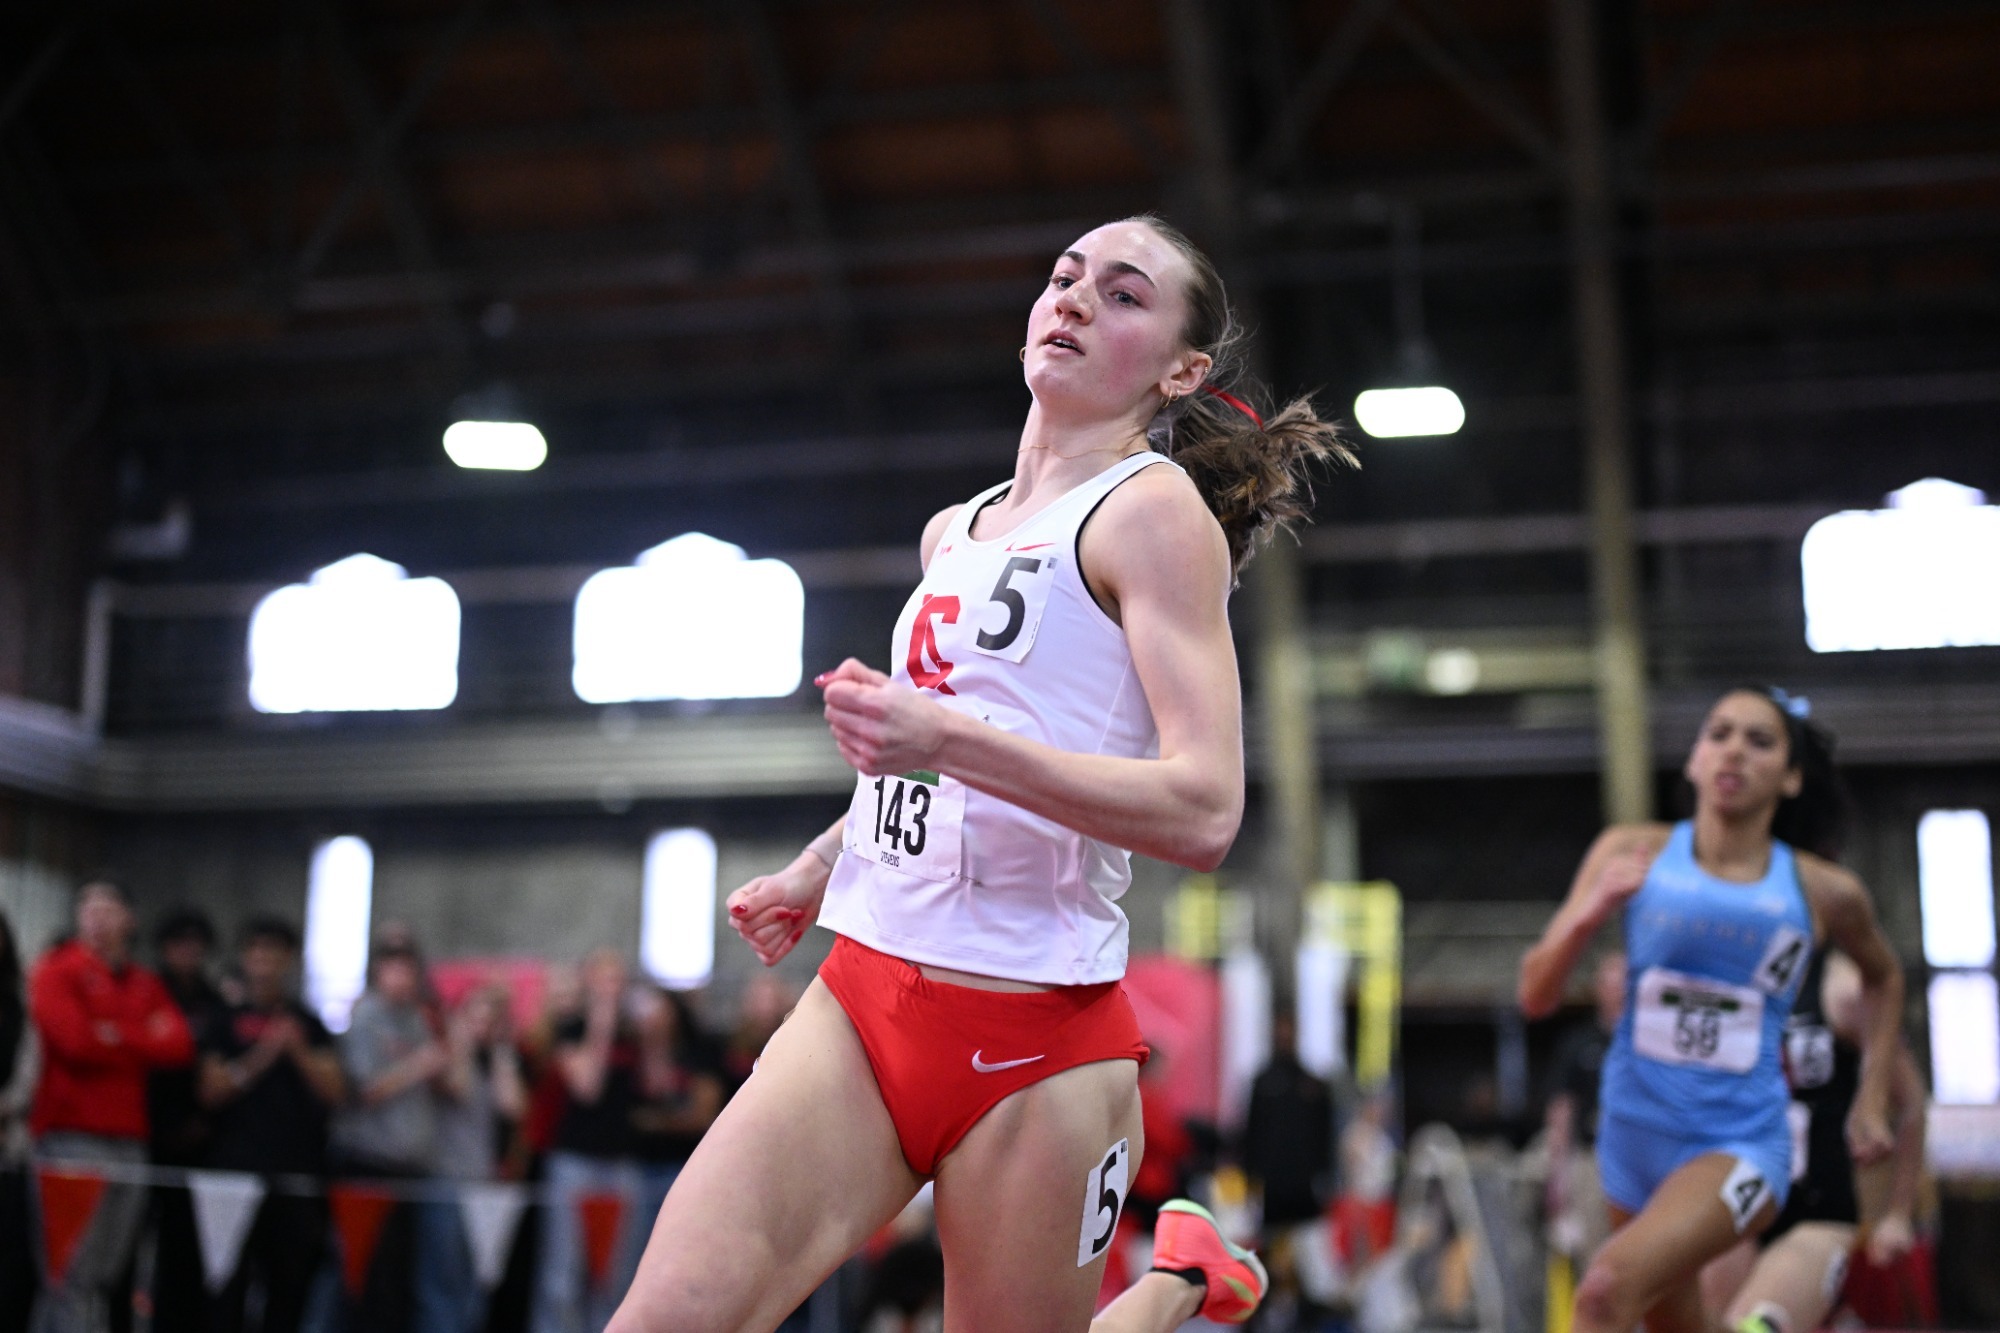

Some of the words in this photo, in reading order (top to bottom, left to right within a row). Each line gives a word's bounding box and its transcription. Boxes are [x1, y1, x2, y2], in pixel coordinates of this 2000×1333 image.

[976, 556, 1042, 651] 5
[874, 775, 931, 856] 143
[1768, 938, 1802, 988] 4
[1091, 1151, 1119, 1255] 5
[1734, 1176, 1766, 1217] 4
